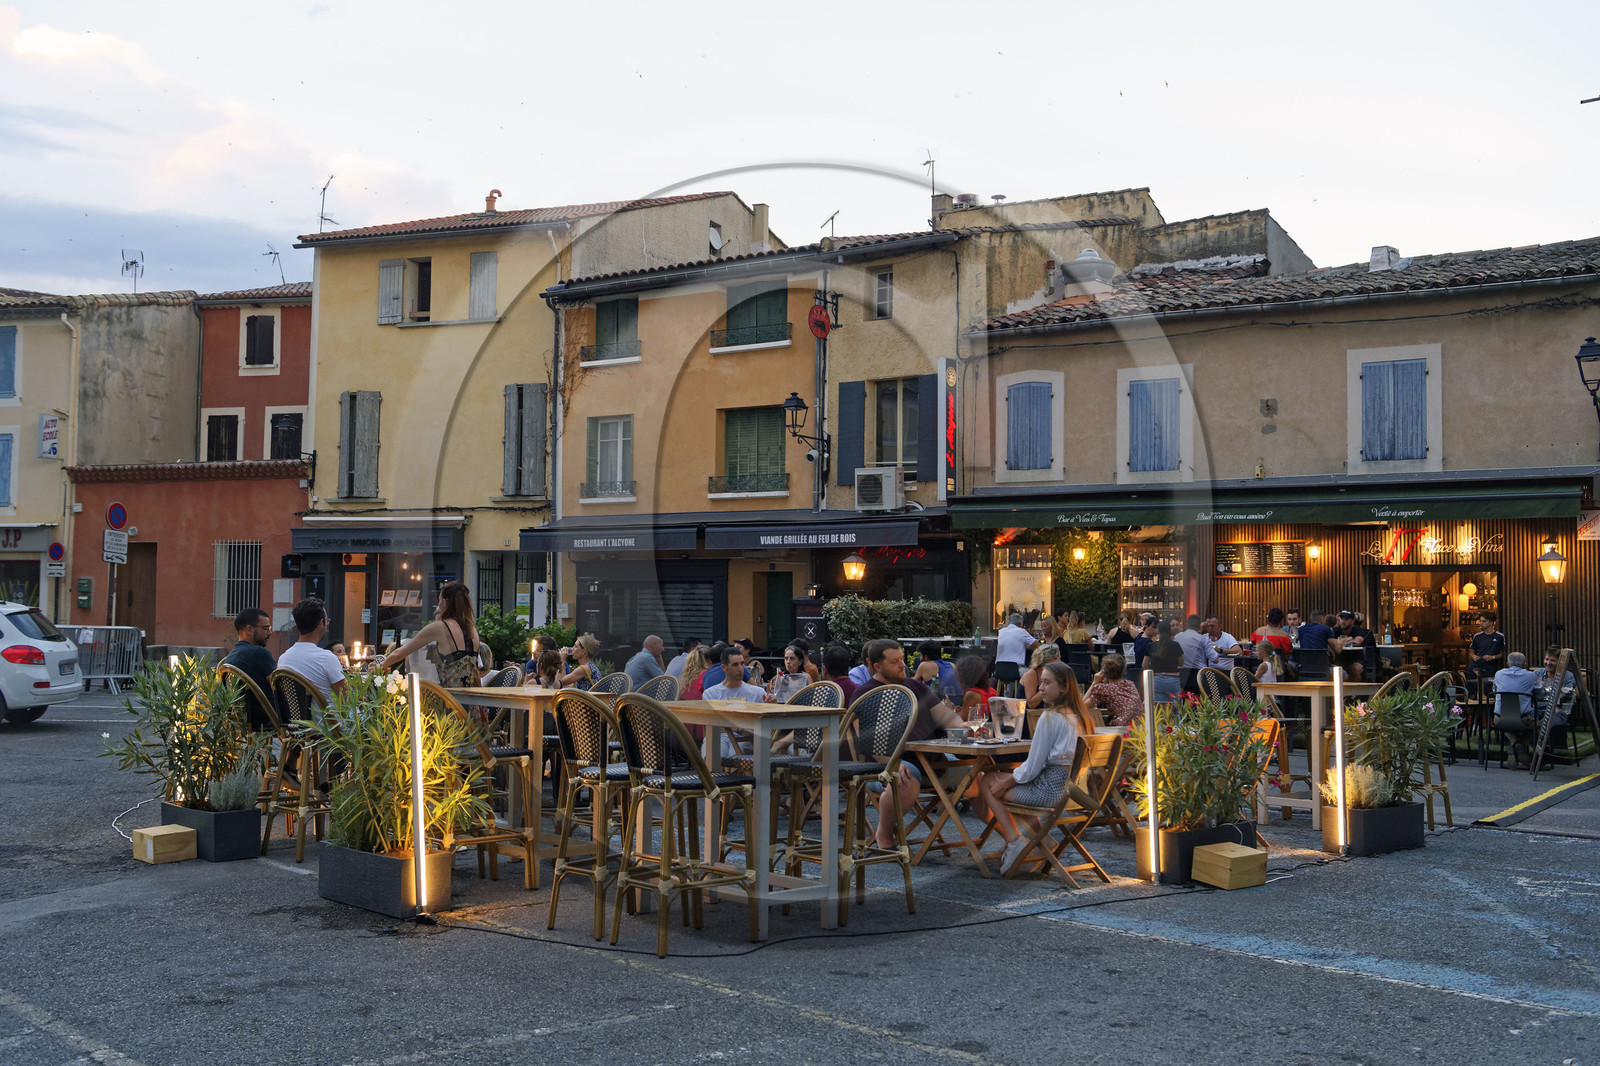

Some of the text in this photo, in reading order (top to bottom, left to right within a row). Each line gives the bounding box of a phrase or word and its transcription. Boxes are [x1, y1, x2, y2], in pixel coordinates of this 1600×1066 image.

[43, 418, 58, 429] AUTO
[42, 430, 58, 441] ECOLE
[1371, 506, 1391, 517] Vente
[1397, 509, 1425, 518] emporter
[1579, 513, 1588, 522] IV
[1057, 514, 1070, 523] Bar
[1076, 513, 1090, 523] Vins
[1090, 514, 1098, 523] &
[1098, 513, 1116, 525] Tapas
[350, 538, 392, 546] IMMOBILIER
[573, 538, 635, 548] RESTAURANT L'ALCYONE
[760, 533, 856, 545] VIANDE GRILLÉE AU FEU DE BOIS
[1382, 527, 1430, 561] 17
[1420, 537, 1455, 554] Place
[1469, 533, 1504, 553] Vins
